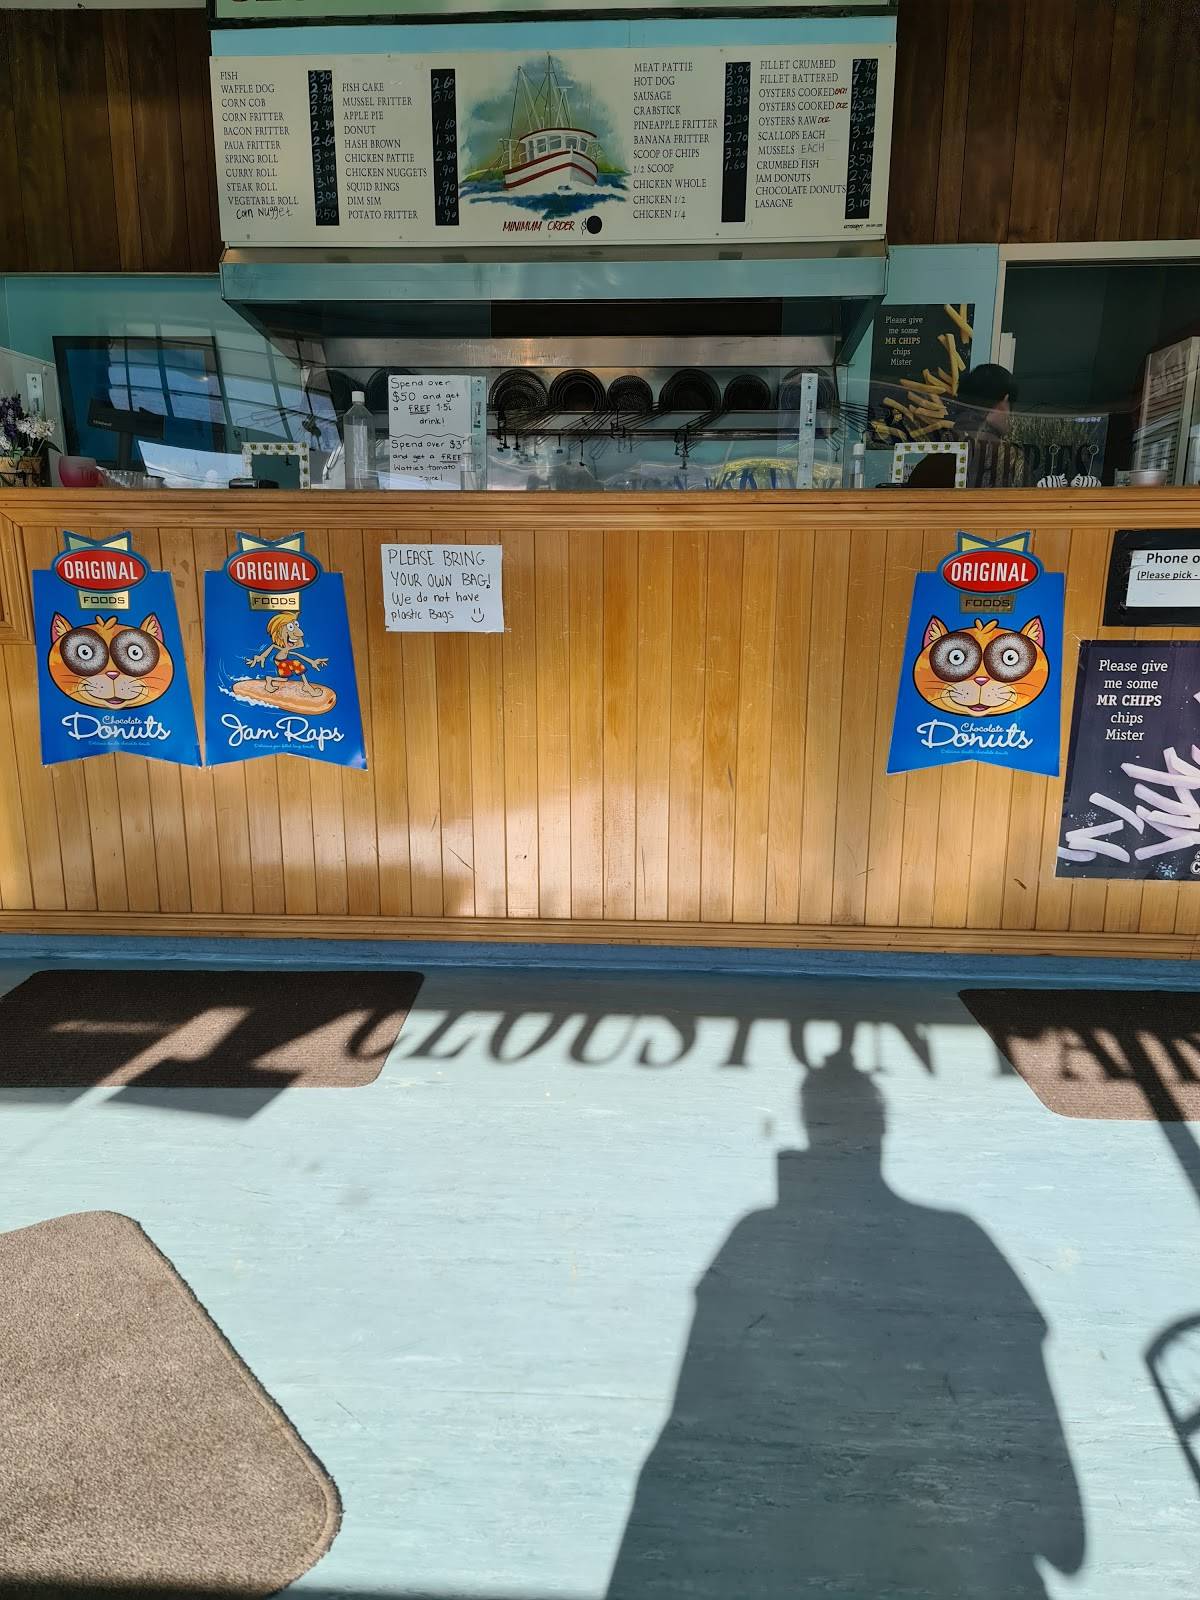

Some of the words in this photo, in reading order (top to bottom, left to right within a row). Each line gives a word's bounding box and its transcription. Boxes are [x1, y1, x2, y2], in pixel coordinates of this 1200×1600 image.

[634, 63, 659, 72] MEAT
[662, 62, 693, 72] PATTIE
[760, 61, 790, 69] FILLET
[793, 60, 835, 69] CRUMBED
[220, 72, 238, 80] FISH
[760, 75, 789, 83] FILLET
[792, 74, 838, 82] BATTERED
[634, 77, 653, 86] HOT
[656, 77, 675, 85] DOG
[221, 85, 252, 93] WAFFLE
[256, 84, 275, 93] DOG
[343, 83, 360, 92] FISH
[363, 83, 384, 91] CAKE
[634, 91, 671, 100] SAUSAGE
[759, 88, 795, 98] OYSTERS
[798, 88, 834, 96] COOKED
[222, 99, 246, 107] CORN
[249, 99, 266, 107] COB
[343, 97, 374, 106] MUSSEL
[378, 97, 412, 105] FRITTER
[634, 106, 680, 115] CRABSTICK
[759, 102, 795, 111] OYSTERS
[798, 102, 834, 110] COOKED
[222, 113, 246, 121] CORN
[250, 113, 284, 121] FRITTER
[344, 112, 368, 120] APPLE
[371, 111, 383, 120] PIE
[634, 120, 679, 129] PINEAPPLE
[683, 120, 718, 128] FRITTER
[759, 117, 795, 126] OYSTERS
[798, 116, 817, 125] RAW
[224, 127, 252, 135] BACON
[256, 127, 289, 135] FRITTER
[344, 126, 376, 134] DONUT
[634, 135, 671, 144] BANANA
[674, 134, 709, 143] FRITTER
[725, 132, 748, 143] 2.70
[759, 131, 799, 140] SCALLOPS
[802, 130, 825, 139] EACH
[225, 141, 243, 149] PAUA
[248, 141, 281, 149] FRITTER
[344, 140, 367, 148] HASH
[370, 140, 400, 148] BROWN
[633, 150, 659, 158] SCOOP
[663, 150, 672, 158] OF
[676, 149, 699, 157] CHIPS
[759, 146, 794, 155] MUSSELS
[801, 143, 824, 153] EACH
[225, 155, 254, 163] SPRING
[258, 155, 278, 163] ROLL
[345, 154, 383, 162] CHICKEN
[387, 154, 414, 162] PATTIE
[849, 154, 871, 168] 3.50
[633, 165, 644, 173] 1/2
[647, 164, 674, 173] SCOOP
[757, 161, 798, 169] CRUMBED
[801, 160, 819, 168] FISH
[226, 169, 253, 177] CURRY
[256, 169, 277, 177] ROLL
[346, 168, 384, 177] CHICKEN
[387, 168, 427, 176] NUGGETS
[633, 180, 671, 188] CHICKEN
[675, 179, 707, 187] WHOLE
[756, 174, 771, 184] JAM
[774, 174, 810, 182] DONUTS
[227, 183, 253, 191] STEAK
[256, 183, 277, 191] ROLL
[346, 183, 372, 191] SQUID
[375, 183, 399, 191] RINGS
[756, 186, 807, 195] CHOCOLATE
[810, 185, 846, 194] DONUTS
[228, 197, 275, 205] VEGETABLE
[278, 197, 299, 205] ROLL
[347, 197, 364, 205] DIM
[367, 197, 381, 205] SIM
[633, 195, 671, 204] CHICKEN
[675, 196, 686, 204] 1/2
[755, 199, 792, 208] LASAGNE
[848, 199, 869, 212] 3.10
[348, 211, 381, 219] POTATO
[384, 211, 417, 219] FRITTER
[633, 210, 671, 218] CHICKEN
[675, 211, 686, 219] 1/4
[503, 221, 542, 231] MINIMUM
[547, 221, 575, 230] ORDER
[885, 316, 906, 324] Please
[893, 348, 910, 356] chips
[391, 378, 423, 389] Spend
[393, 391, 416, 402] $50
[446, 392, 460, 402] get
[392, 440, 422, 450] Spend
[413, 454, 424, 463] get
[388, 549, 435, 565] PLEASE
[443, 551, 485, 566] BRING
[1147, 553, 1188, 563] Phone
[64, 561, 138, 579] ORIGINAL
[236, 561, 310, 581] ORIGINAL
[951, 562, 1028, 582] ORIGINAL
[391, 571, 422, 586] YOUR
[427, 574, 451, 587] OWN
[462, 573, 490, 588] BAG!
[1137, 571, 1170, 580] (Please
[1173, 571, 1192, 580] pick
[254, 596, 296, 605] FOODS
[392, 592, 411, 606] We
[417, 592, 427, 602] do
[434, 592, 450, 602] not
[456, 592, 479, 601] have
[965, 599, 1010, 607] FOODS
[391, 609, 421, 622] plastic
[429, 609, 454, 623] Bags
[1099, 660, 1137, 671] Please
[1142, 660, 1167, 674] give
[1104, 680, 1122, 689] me
[1127, 679, 1158, 689] some
[1097, 695, 1117, 705] MR
[1122, 695, 1161, 706] CHIPS
[102, 715, 142, 724] Chocolate
[1111, 712, 1143, 726] chips
[62, 712, 171, 740] Donuts
[961, 723, 1004, 732] Chocolate
[221, 714, 279, 746] Jam
[276, 717, 344, 751] Raps
[917, 719, 1033, 748] Donuts
[1105, 729, 1144, 741] Mister
